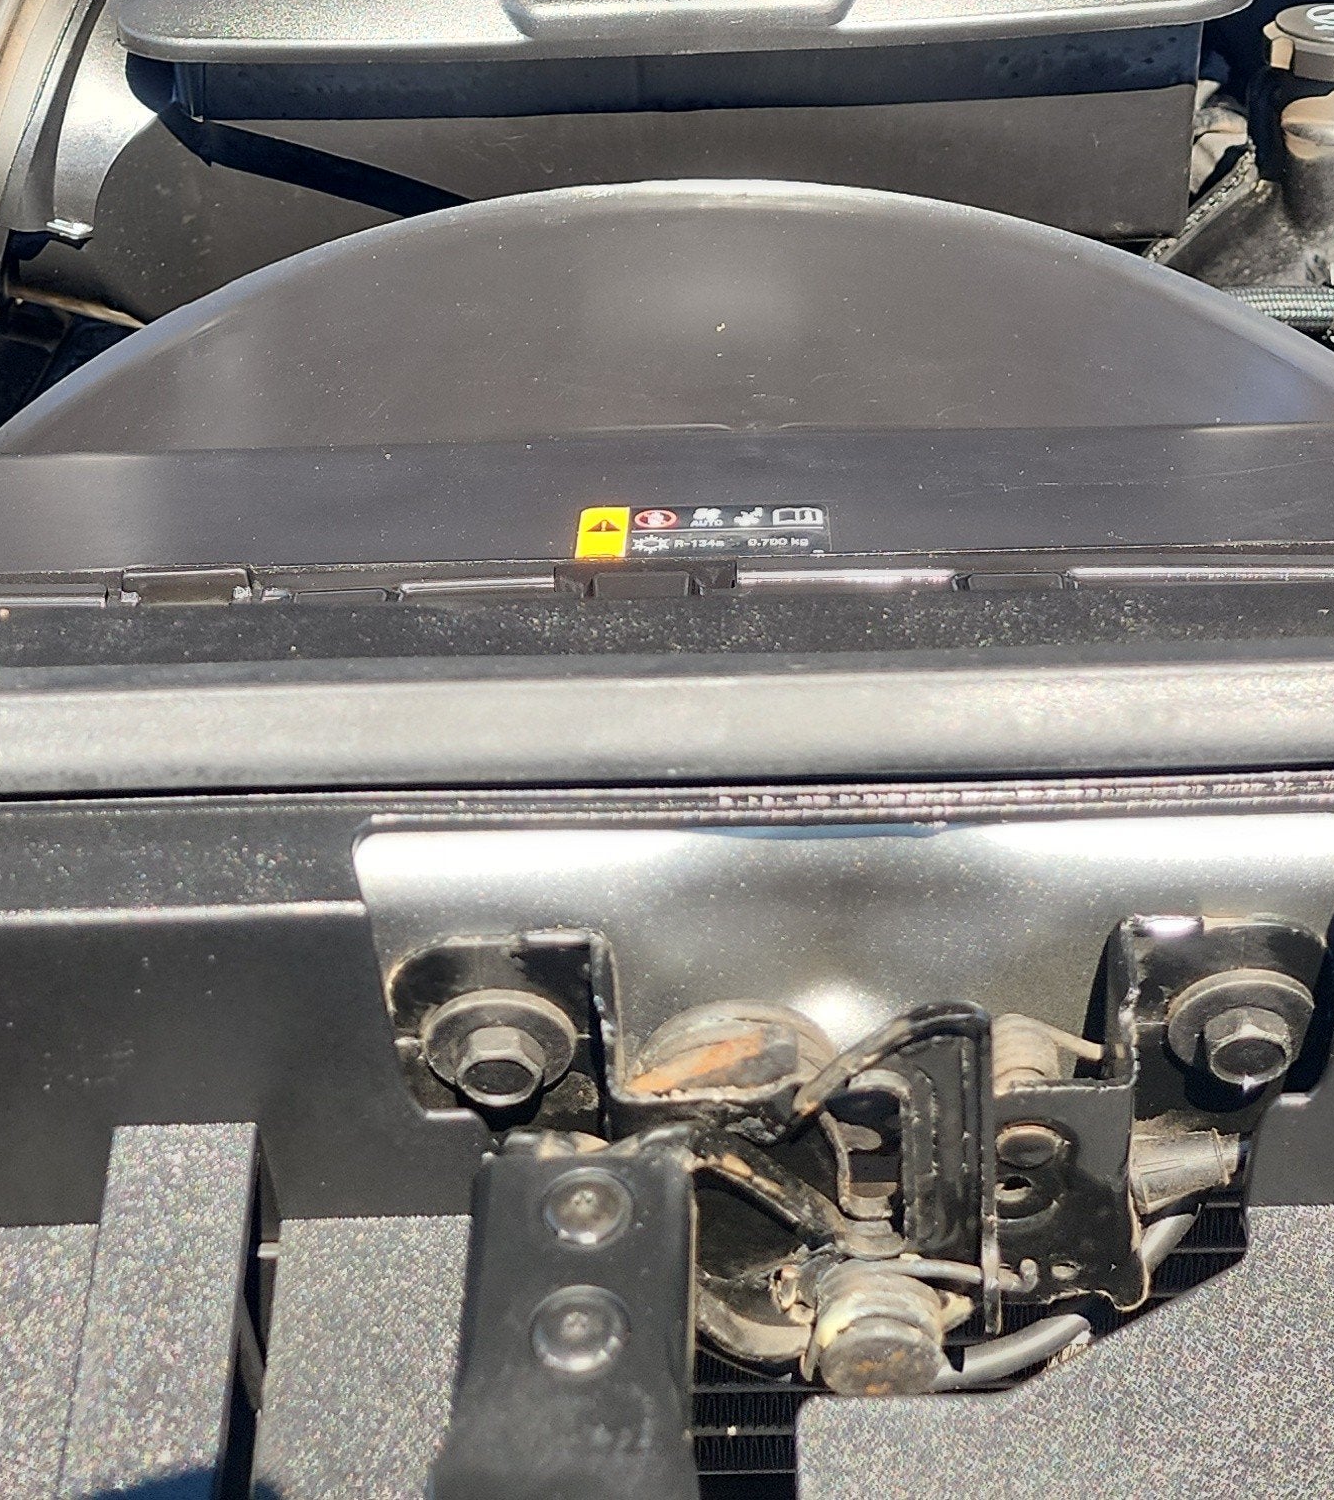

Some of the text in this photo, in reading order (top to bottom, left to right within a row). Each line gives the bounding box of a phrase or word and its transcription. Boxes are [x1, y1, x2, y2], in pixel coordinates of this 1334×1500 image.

[690, 519, 723, 527] AUTO
[674, 537, 809, 548] R-134a 0.700 kg
